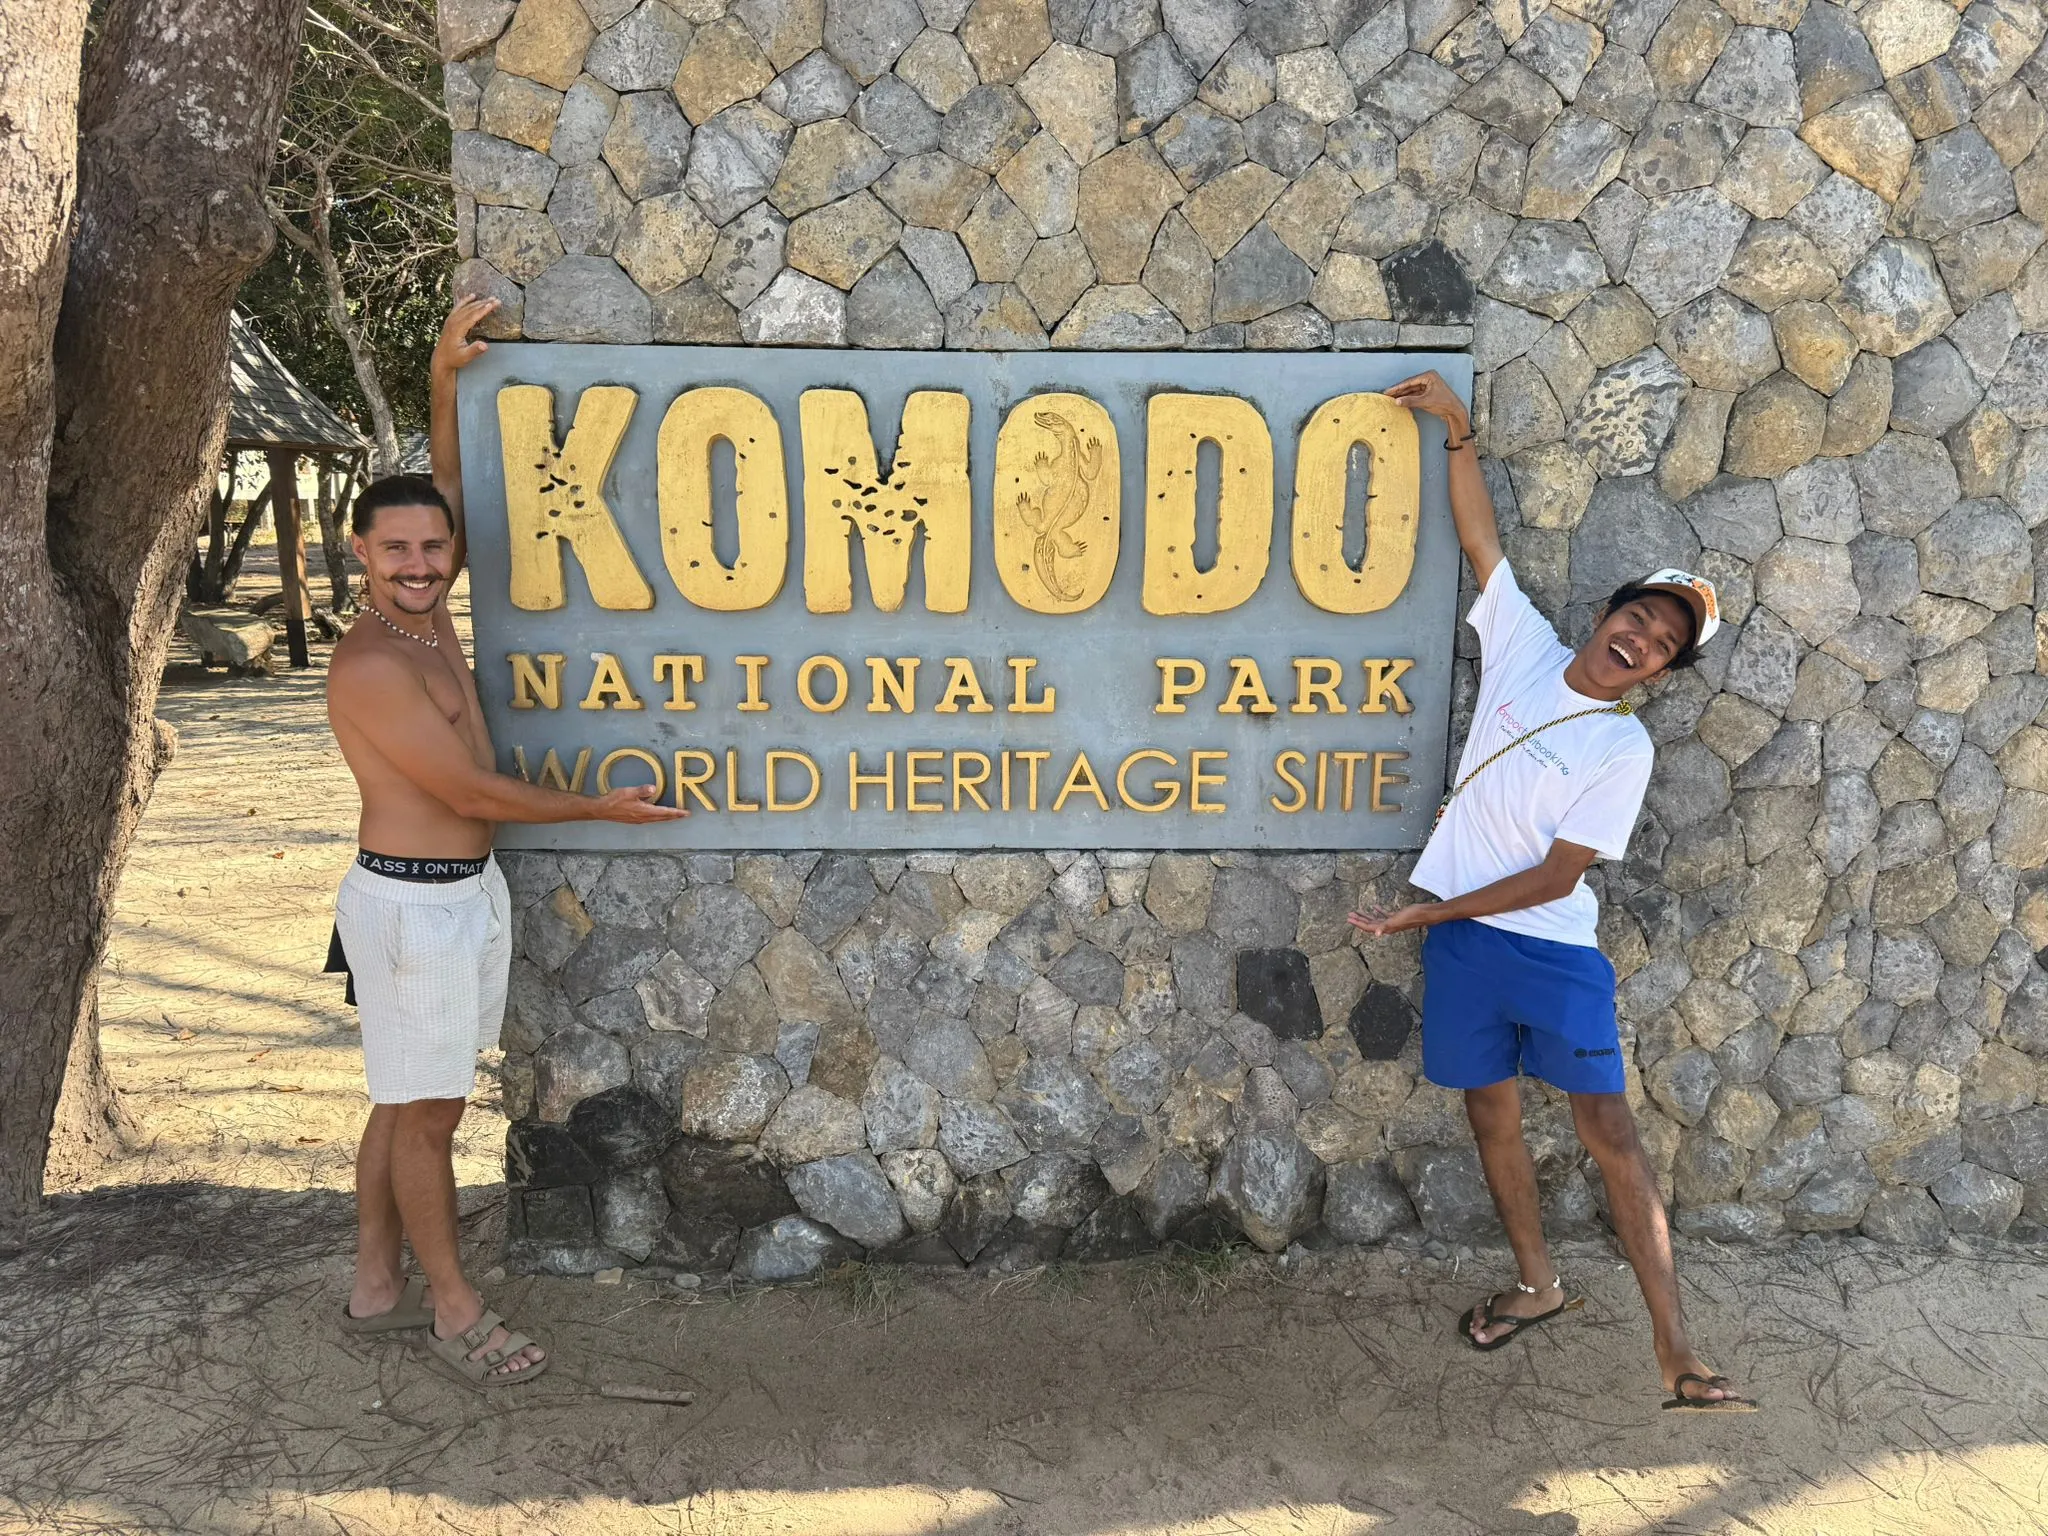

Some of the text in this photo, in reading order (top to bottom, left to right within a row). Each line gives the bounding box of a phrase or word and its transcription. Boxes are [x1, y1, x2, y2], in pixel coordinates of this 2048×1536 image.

[497, 385, 1420, 615] KOMODO
[506, 652, 1415, 714] NATIONAL PARK
[512, 744, 1410, 814] WORLD HERITAGE SITE
[369, 858, 406, 873] ASS
[424, 862, 448, 874] ON
[450, 862, 481, 874] THAT
